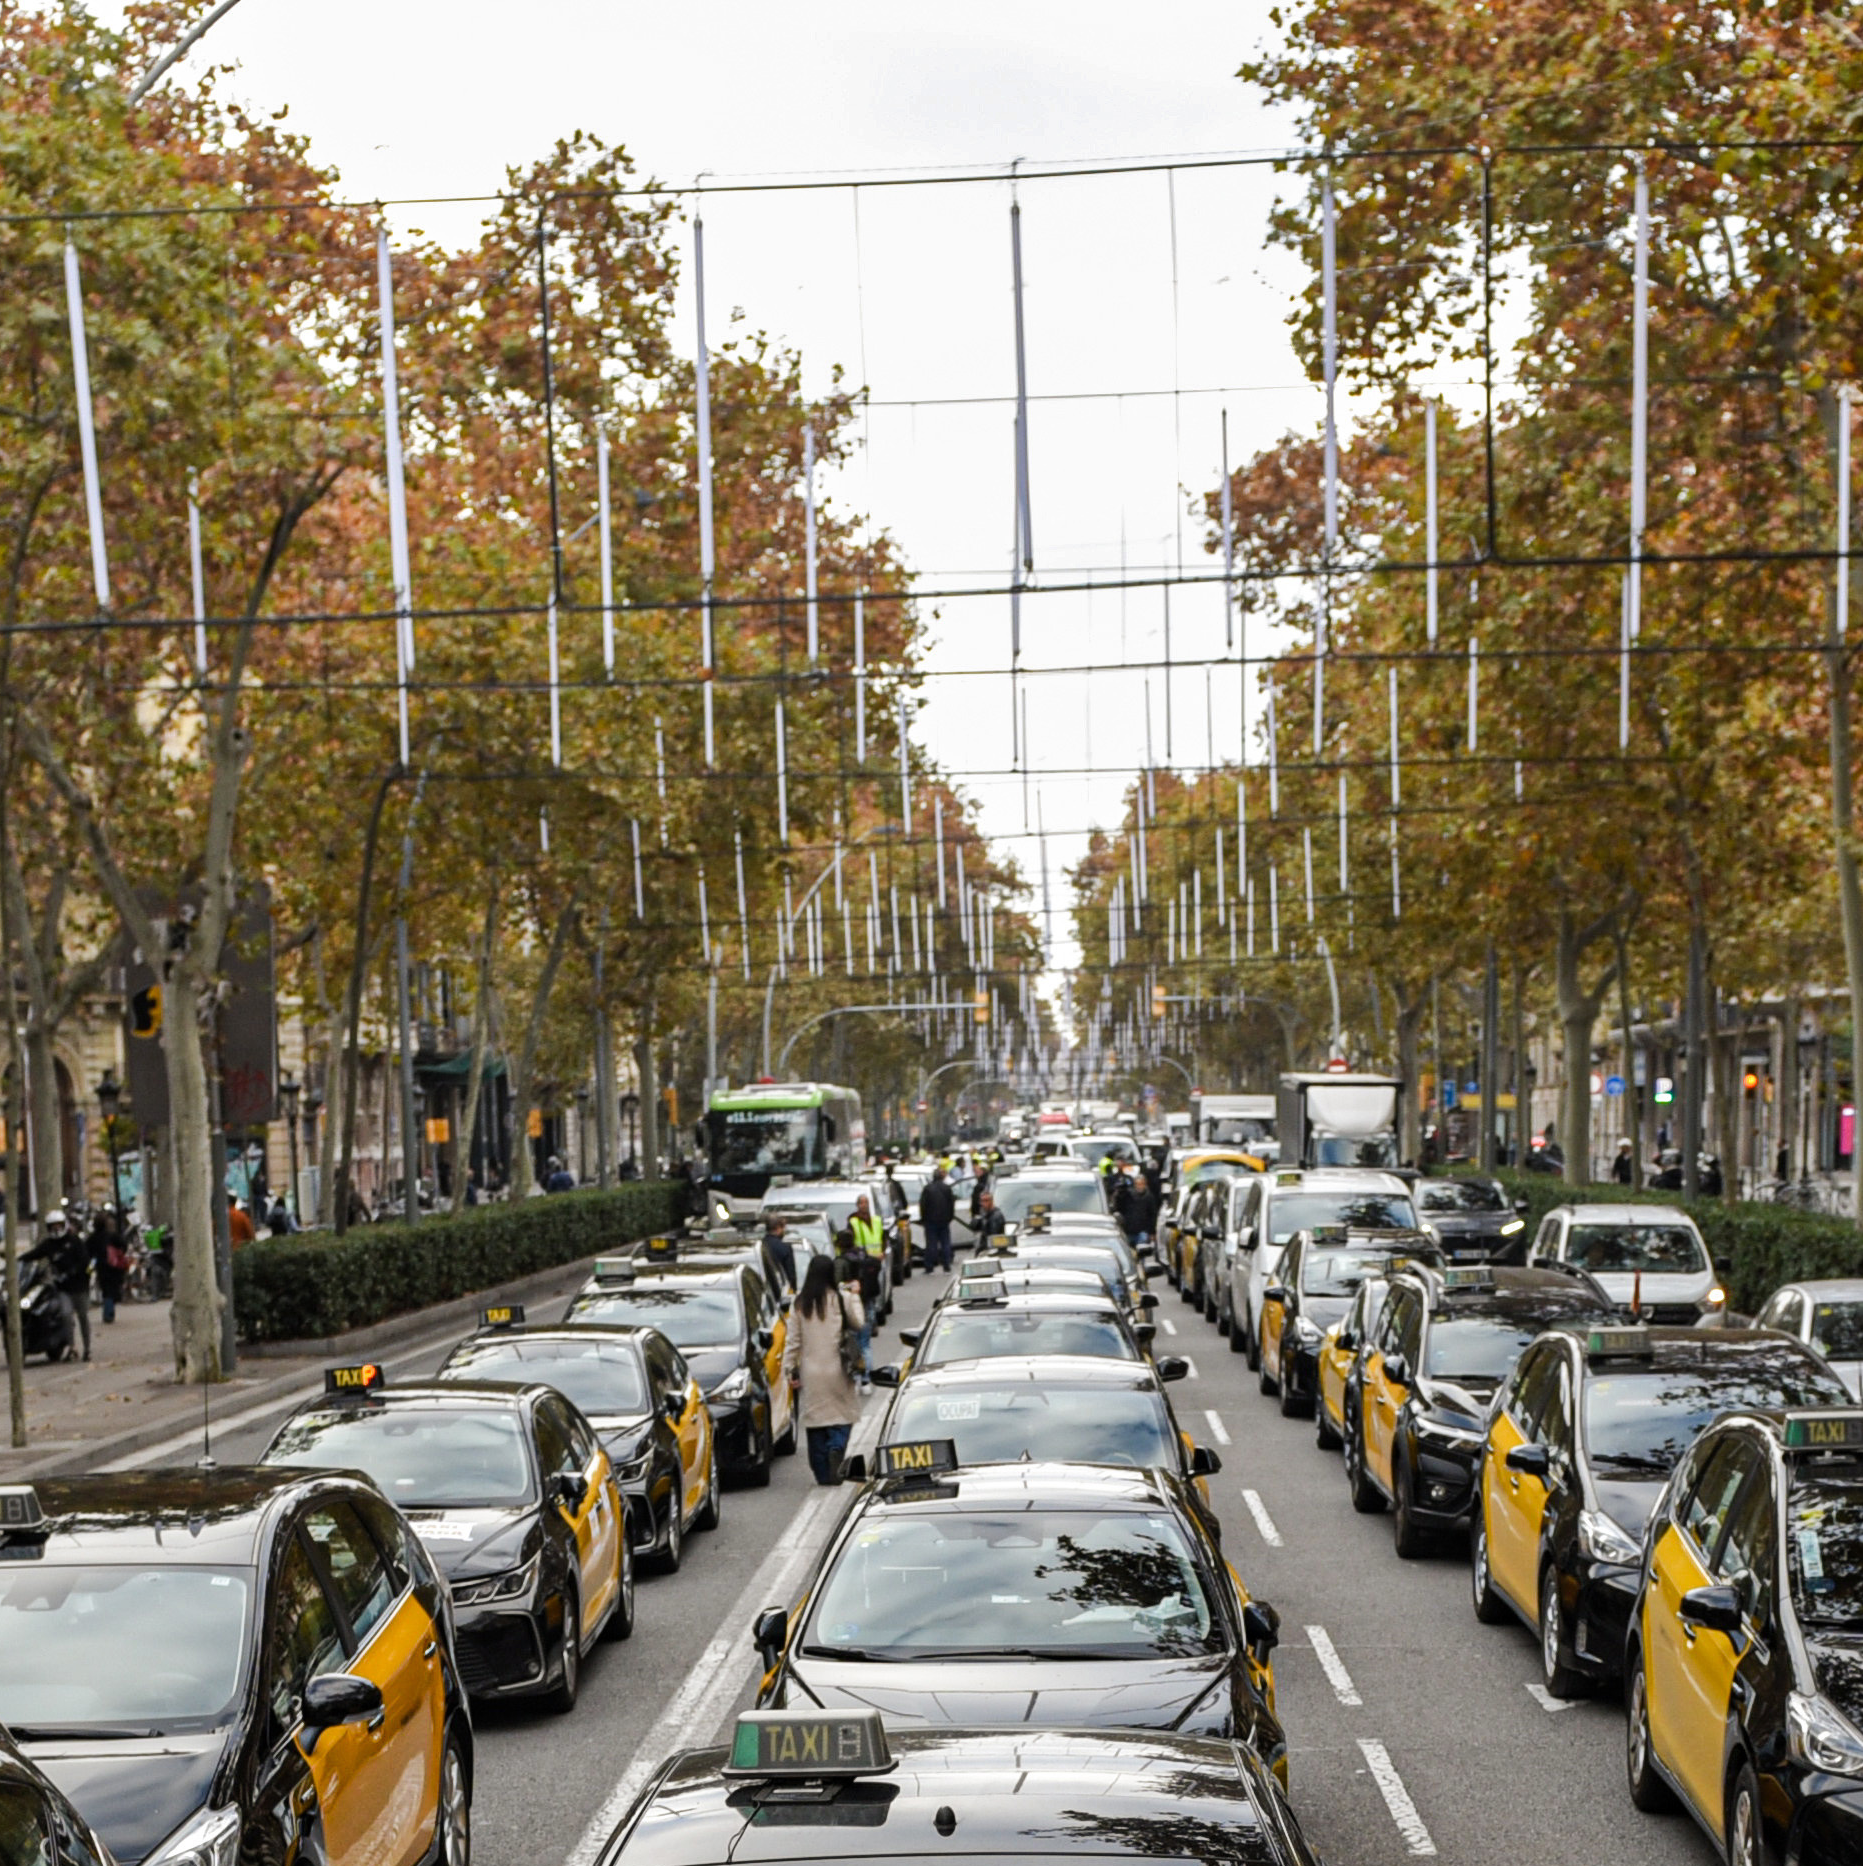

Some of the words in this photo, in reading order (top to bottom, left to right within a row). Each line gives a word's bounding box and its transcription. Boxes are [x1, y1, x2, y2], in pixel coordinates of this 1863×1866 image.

[487, 1308, 511, 1323] TAXI
[940, 1401, 978, 1419] OCUPAT
[1807, 1420, 1845, 1442] TAXI
[889, 1444, 934, 1470] TAXI
[765, 1724, 829, 1762] TAXI
